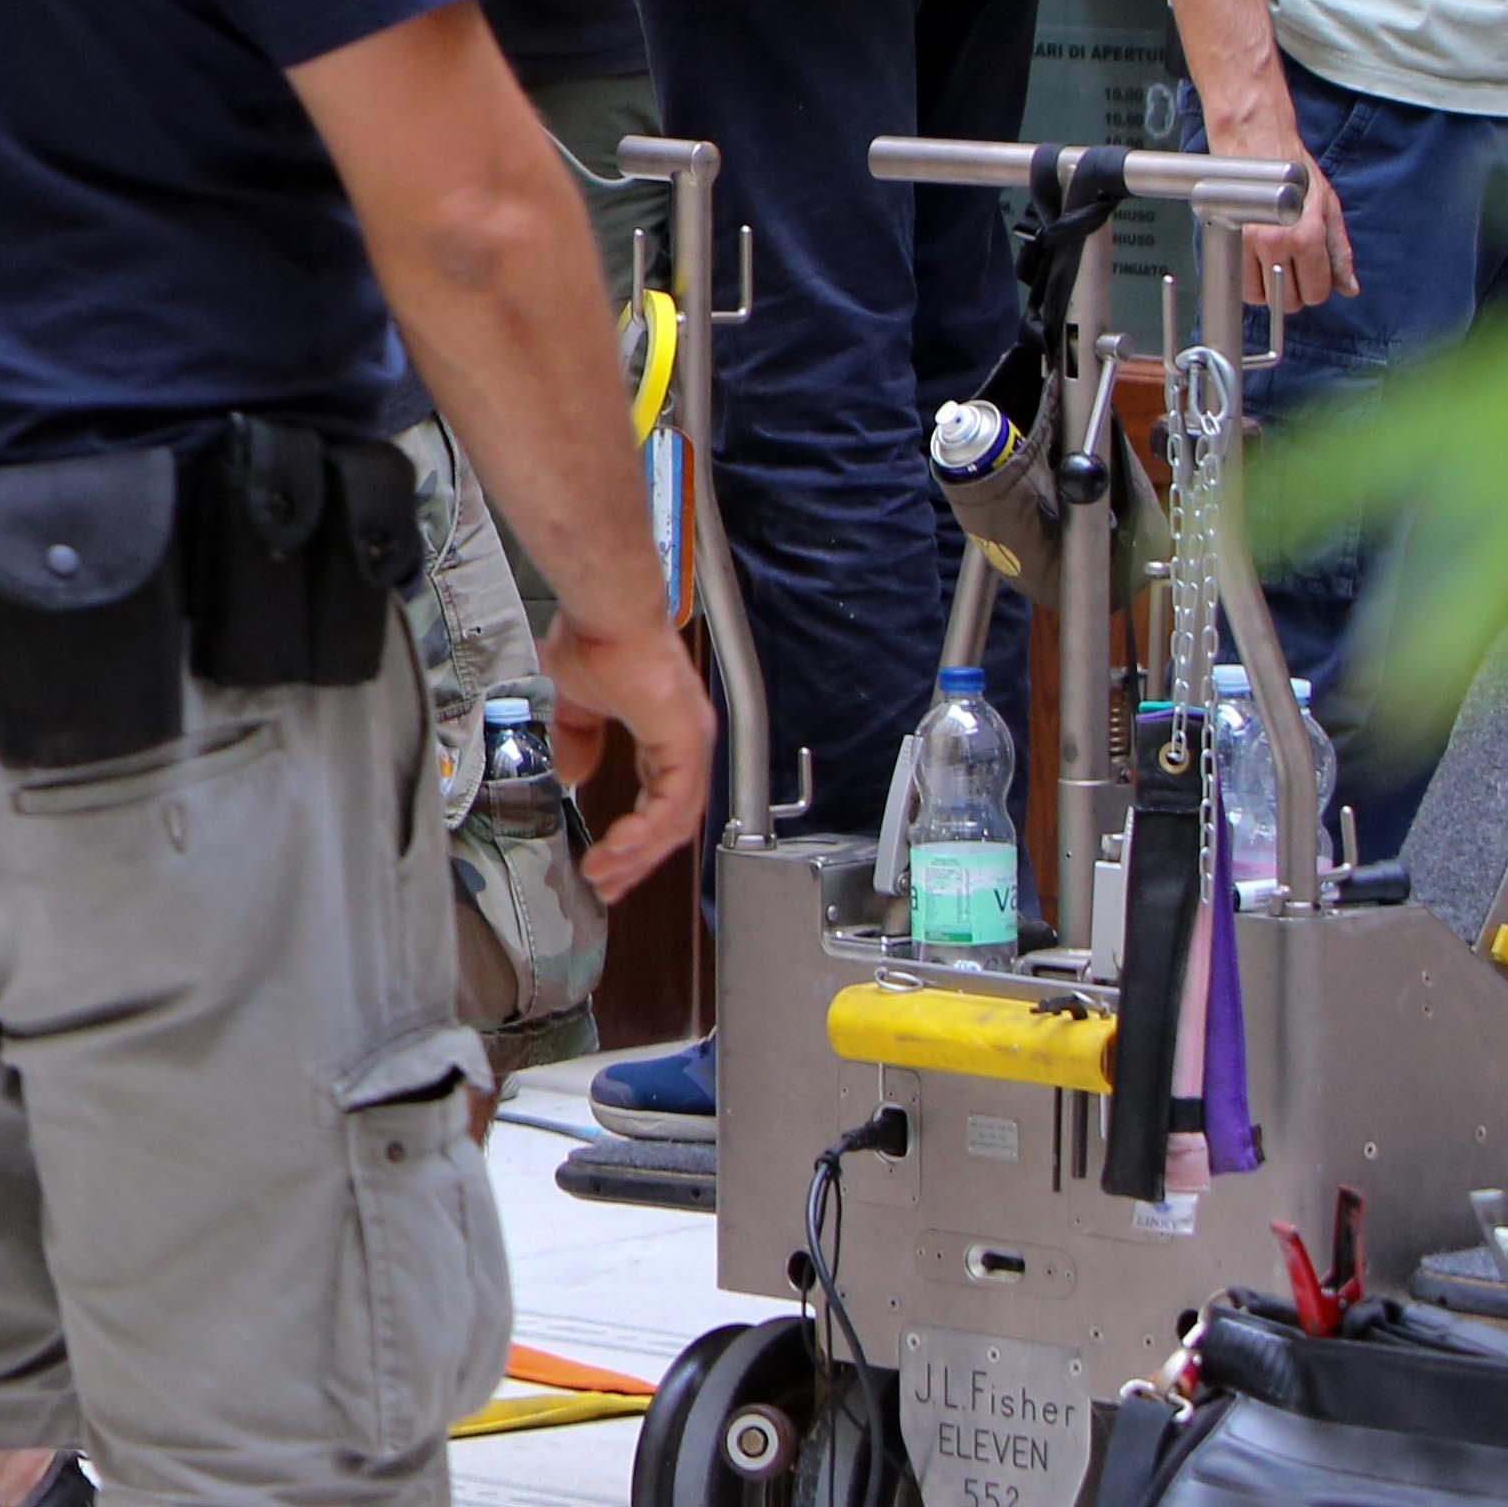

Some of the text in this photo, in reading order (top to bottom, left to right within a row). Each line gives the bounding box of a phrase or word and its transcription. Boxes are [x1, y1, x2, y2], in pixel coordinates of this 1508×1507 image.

[1035, 43, 1063, 59] ARI
[1114, 209, 1155, 223] HIUSO
[1112, 232, 1155, 247] HIUSO
[938, 1421, 1049, 1472] ELEVEN
